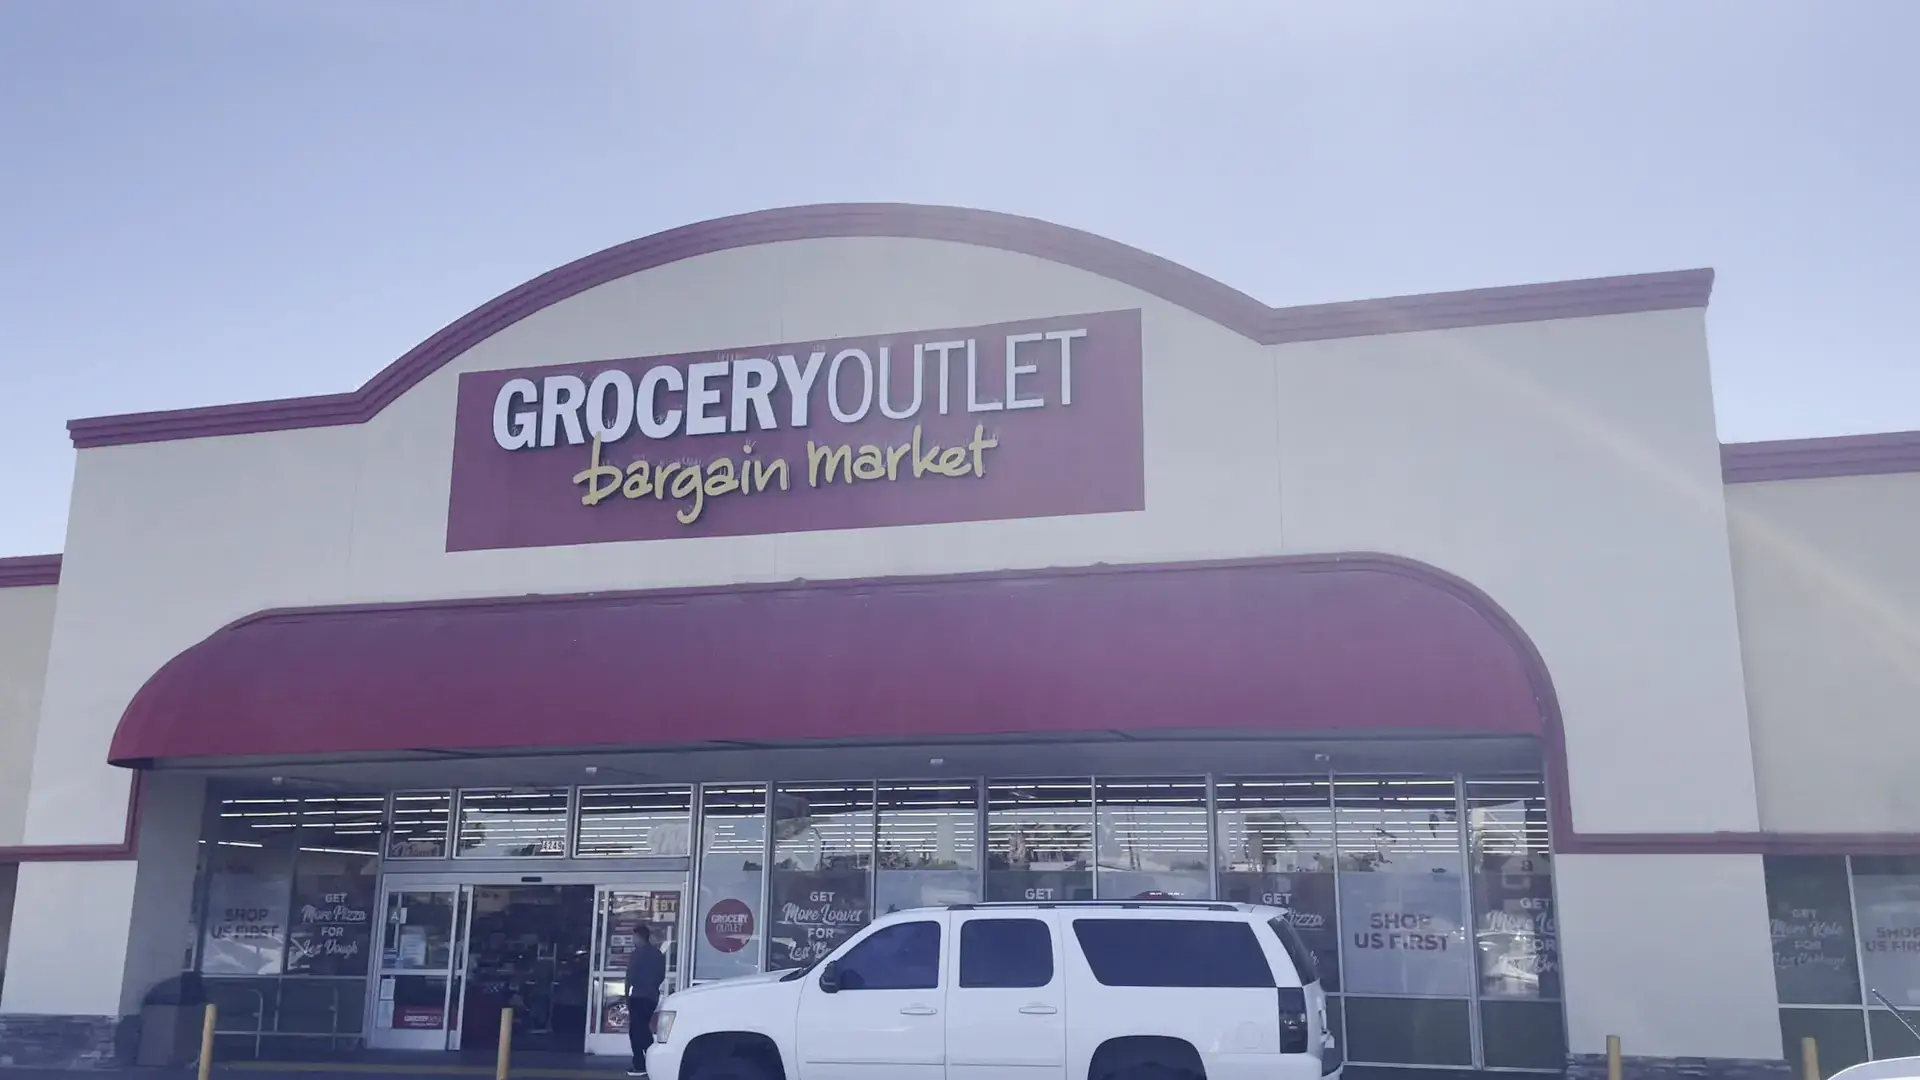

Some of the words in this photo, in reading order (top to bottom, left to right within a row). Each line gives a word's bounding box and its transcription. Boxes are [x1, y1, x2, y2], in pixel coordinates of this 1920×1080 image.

[573, 431, 790, 524] bargain
[808, 425, 998, 488] market
[325, 893, 347, 903] GET
[808, 891, 836, 902] GET
[1025, 888, 1054, 900] GET
[1262, 893, 1292, 905] GET
[1520, 898, 1550, 909] GET
[225, 908, 269, 922] SHOP
[711, 914, 748, 923] GROCERY
[782, 902, 819, 925] More
[212, 926, 232, 938] US
[235, 925, 278, 939] FIRST
[321, 926, 344, 936] FOR
[716, 923, 743, 932] OUTLET
[807, 927, 834, 939] FOR
[1355, 932, 1384, 949] US
[1865, 941, 1887, 951] US
